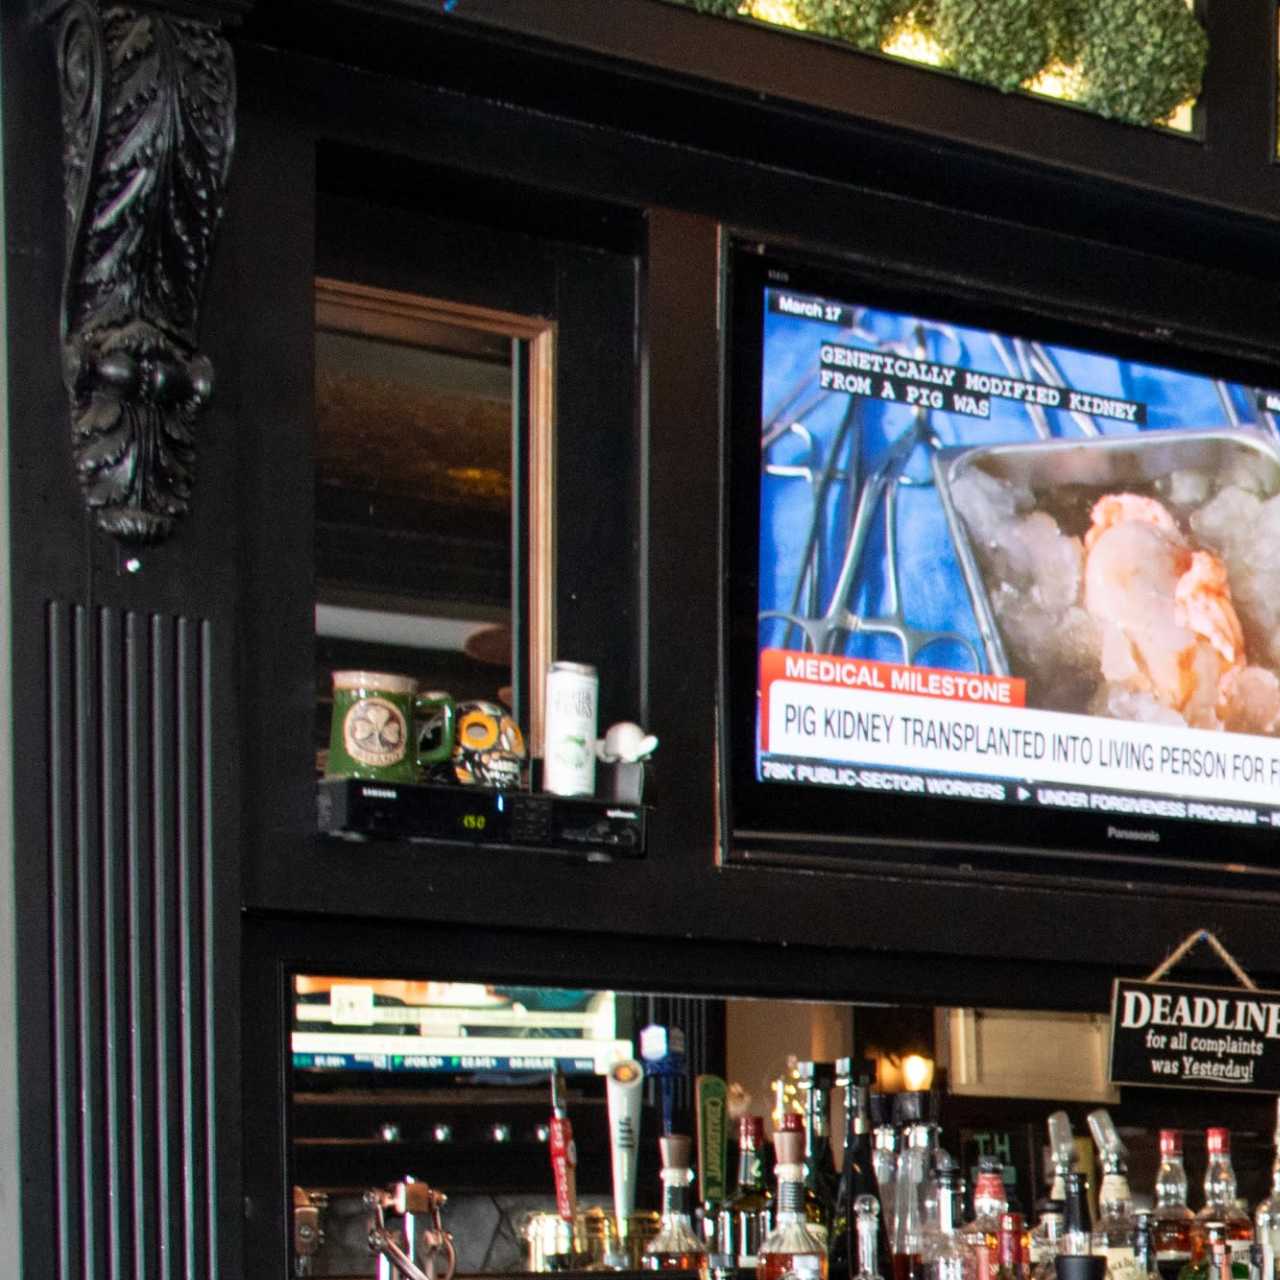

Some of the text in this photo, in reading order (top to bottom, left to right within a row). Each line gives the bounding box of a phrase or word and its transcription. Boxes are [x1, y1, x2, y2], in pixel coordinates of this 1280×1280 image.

[779, 297, 841, 321] March 17
[820, 345, 1137, 422] GENETICALLY MODIFIED KIDNEY
[820, 370, 990, 417] FROM A PIG WAS
[785, 656, 1011, 703] MEDICAL MILESTONE
[784, 703, 816, 736] PIG
[824, 708, 894, 744] KIDNEY
[901, 716, 1045, 760] TRANSPLANTED
[1052, 734, 1093, 765] INTO
[1099, 738, 1154, 772] LIVING
[1160, 745, 1227, 781] PERSON
[1232, 754, 1264, 783] FOR
[797, 765, 925, 793] PUBLIC-SECTOR
[926, 777, 1006, 801] WORKERS
[1037, 788, 1088, 807] UNDER
[1091, 792, 1186, 818] FORGIVENESS
[1187, 803, 1257, 825] PROGRAM
[1107, 825, 1160, 843] Panasonic
[1146, 1028, 1263, 1058] for all complaints
[1151, 1056, 1254, 1080] was Yesterday!
